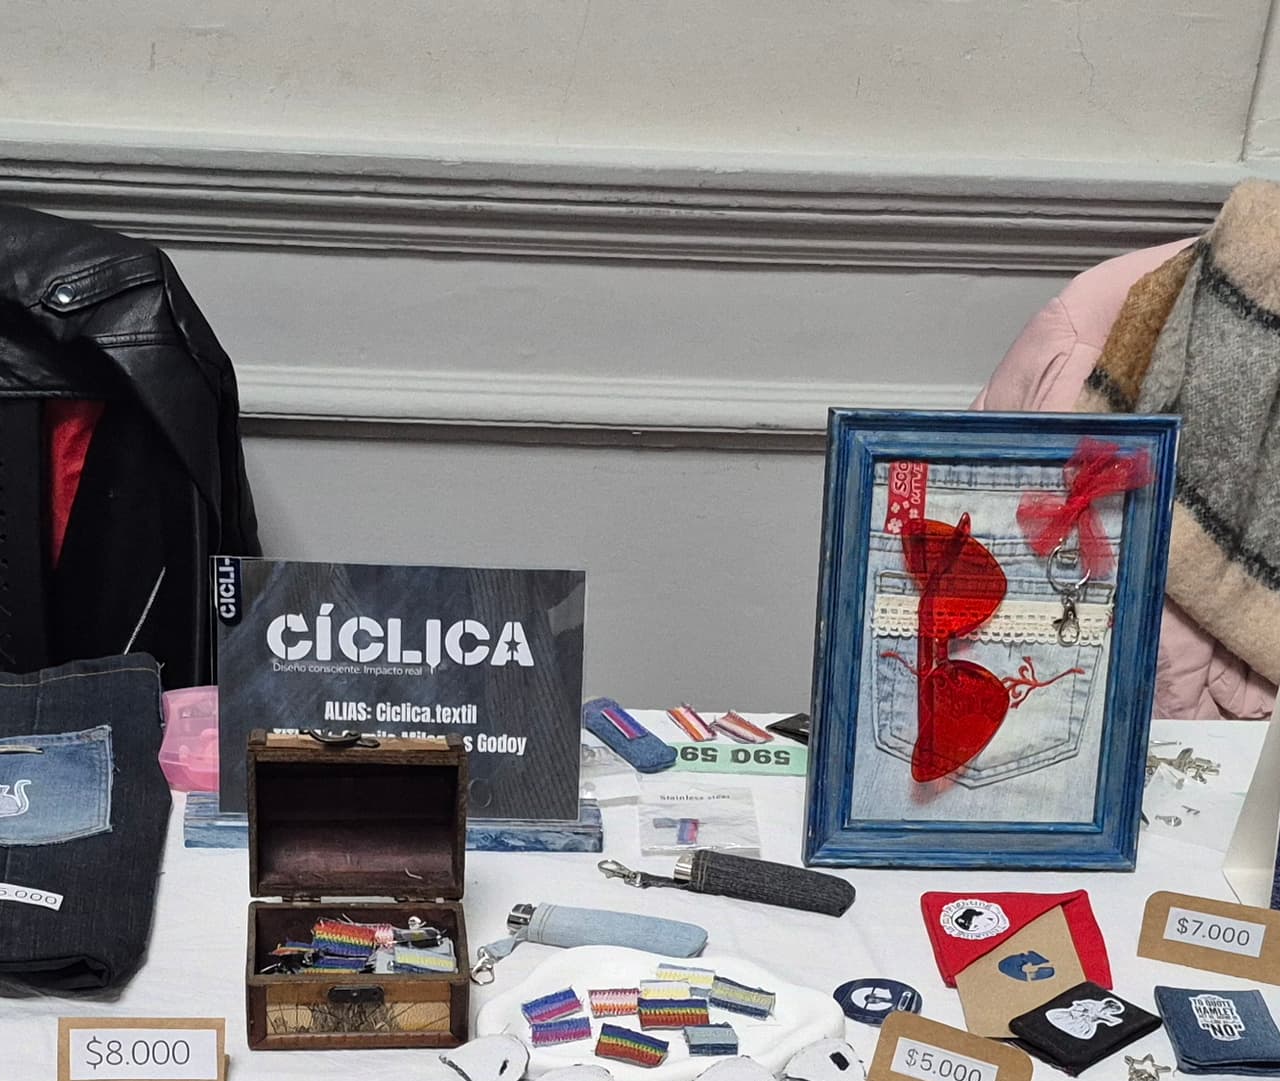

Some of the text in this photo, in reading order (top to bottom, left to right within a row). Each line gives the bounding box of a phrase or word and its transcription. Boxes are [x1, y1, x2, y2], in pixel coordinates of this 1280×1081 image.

[266, 603, 535, 674] CÍCLICA
[364, 664, 403, 677] Impacto
[324, 701, 478, 725] ALIAS: Ciclica.textil
[477, 732, 527, 756] Godoy
[676, 745, 791, 766] 590 59
[1176, 916, 1251, 946] $7.000
[86, 1035, 190, 1070] $8.000
